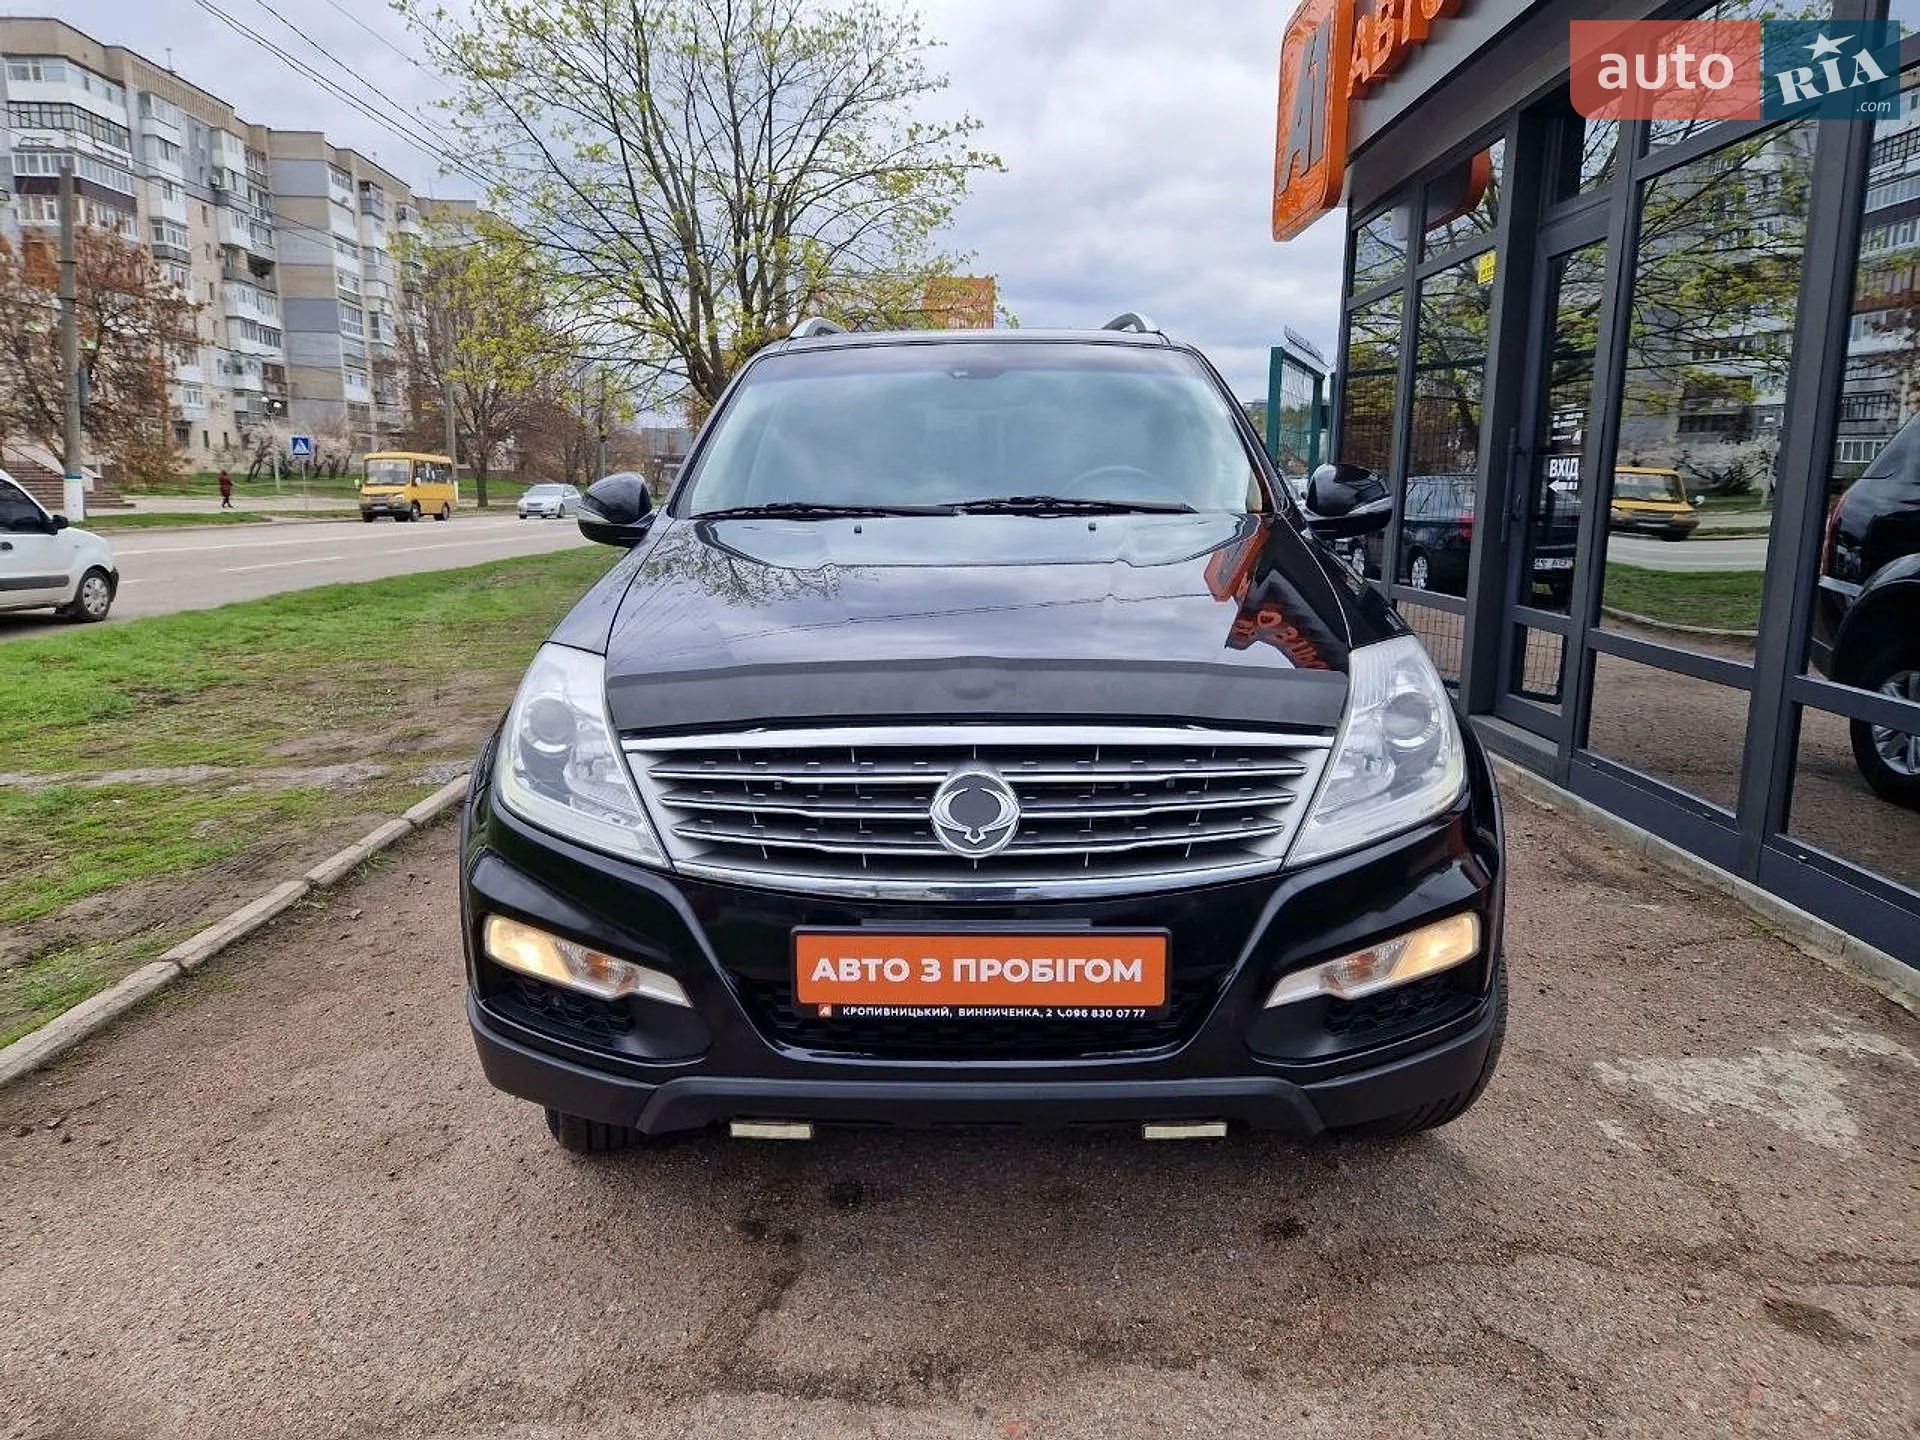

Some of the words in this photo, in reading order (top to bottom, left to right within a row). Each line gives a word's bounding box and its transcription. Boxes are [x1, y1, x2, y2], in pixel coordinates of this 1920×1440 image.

[1549, 457, 1579, 481] ВХІД
[811, 957, 911, 982] АВТО
[952, 957, 1143, 983] ПРОБІГОМ
[842, 1006, 953, 1018] КРОПИВНИЦЬКИЙ,
[958, 1007, 1044, 1019] ВИННИЧЕНКА,
[1045, 1008, 1053, 1017] 2
[1065, 1008, 1089, 1018] 096
[1091, 1008, 1113, 1018] 830
[1116, 1009, 1130, 1018] 07
[1132, 1009, 1146, 1018] 77
